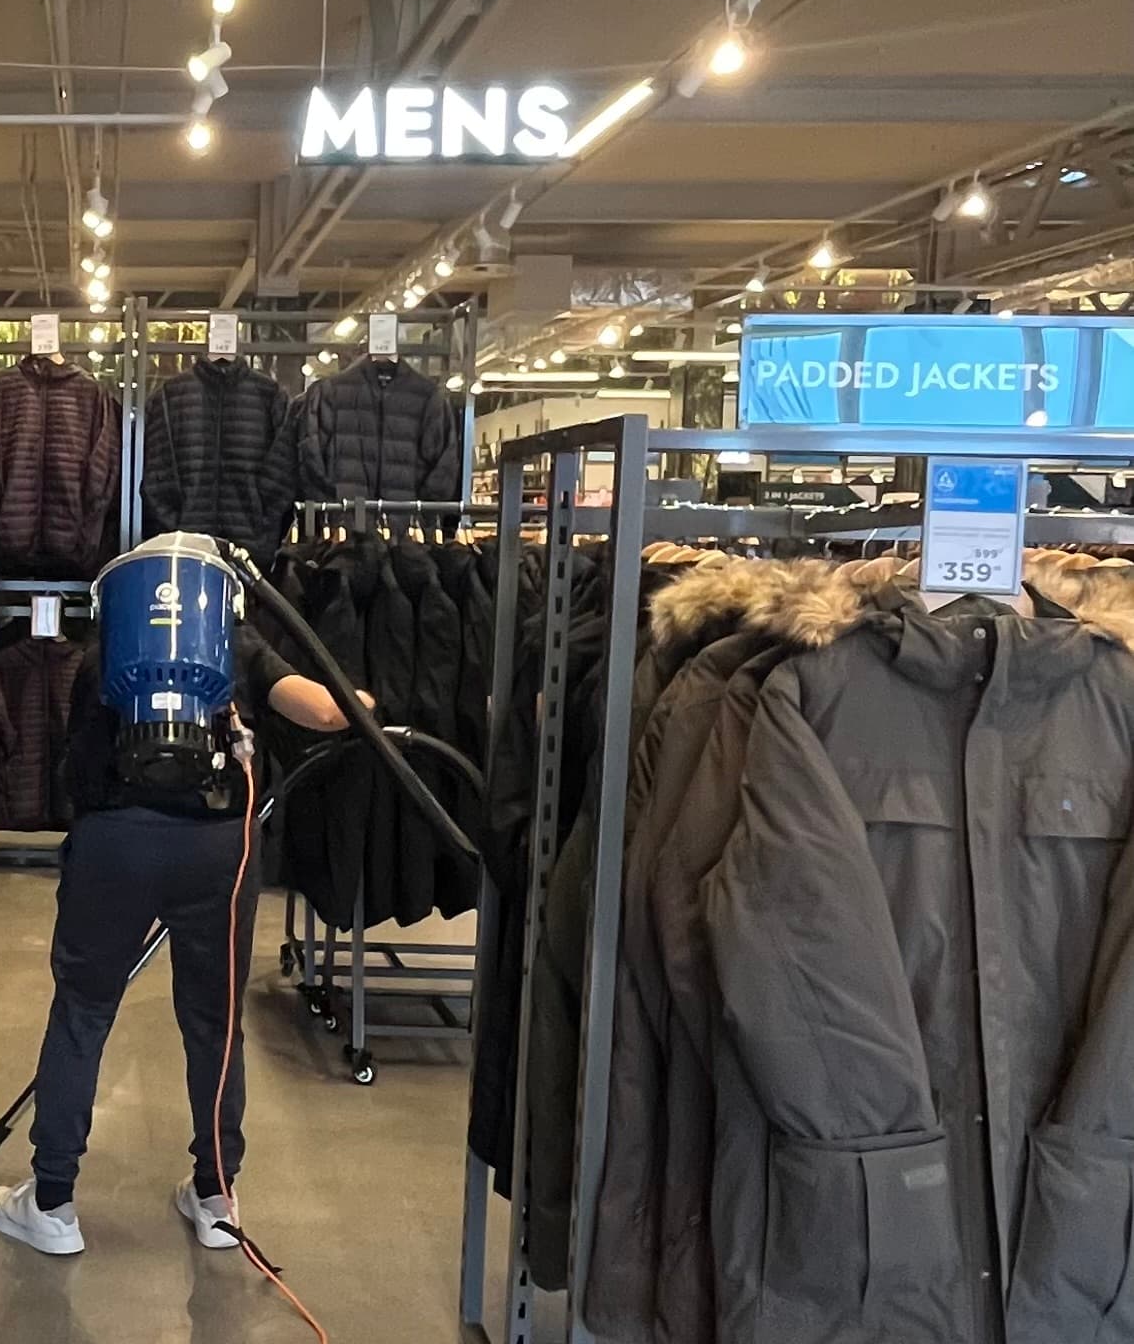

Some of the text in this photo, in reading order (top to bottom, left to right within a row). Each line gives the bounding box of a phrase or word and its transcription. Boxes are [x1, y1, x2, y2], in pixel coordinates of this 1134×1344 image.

[300, 85, 569, 158] MENS
[756, 360, 1059, 397] PADDED JACKETS
